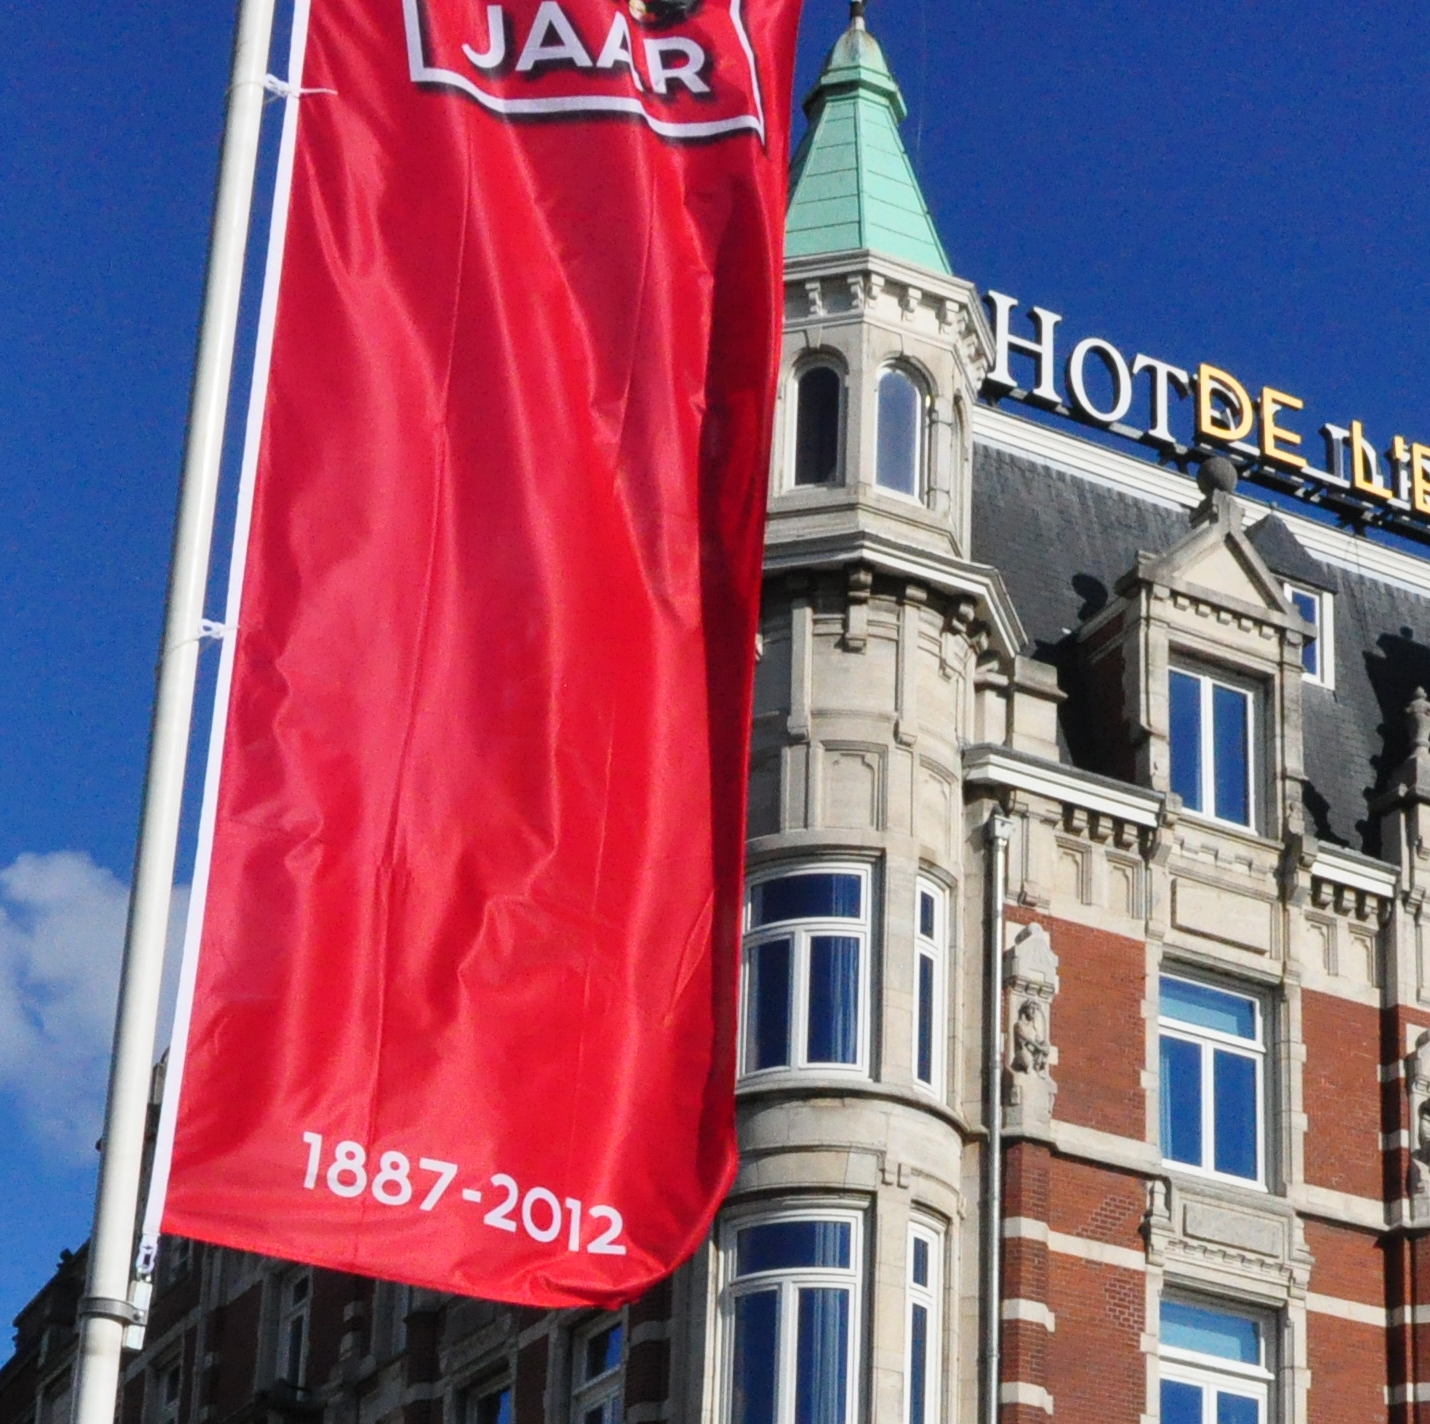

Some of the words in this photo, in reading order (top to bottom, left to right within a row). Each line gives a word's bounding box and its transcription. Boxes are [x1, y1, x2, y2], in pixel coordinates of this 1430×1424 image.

[462, 0, 711, 95] JAAR
[1198, 363, 1308, 469] DE
[303, 1131, 627, 1255] 1887-2012
